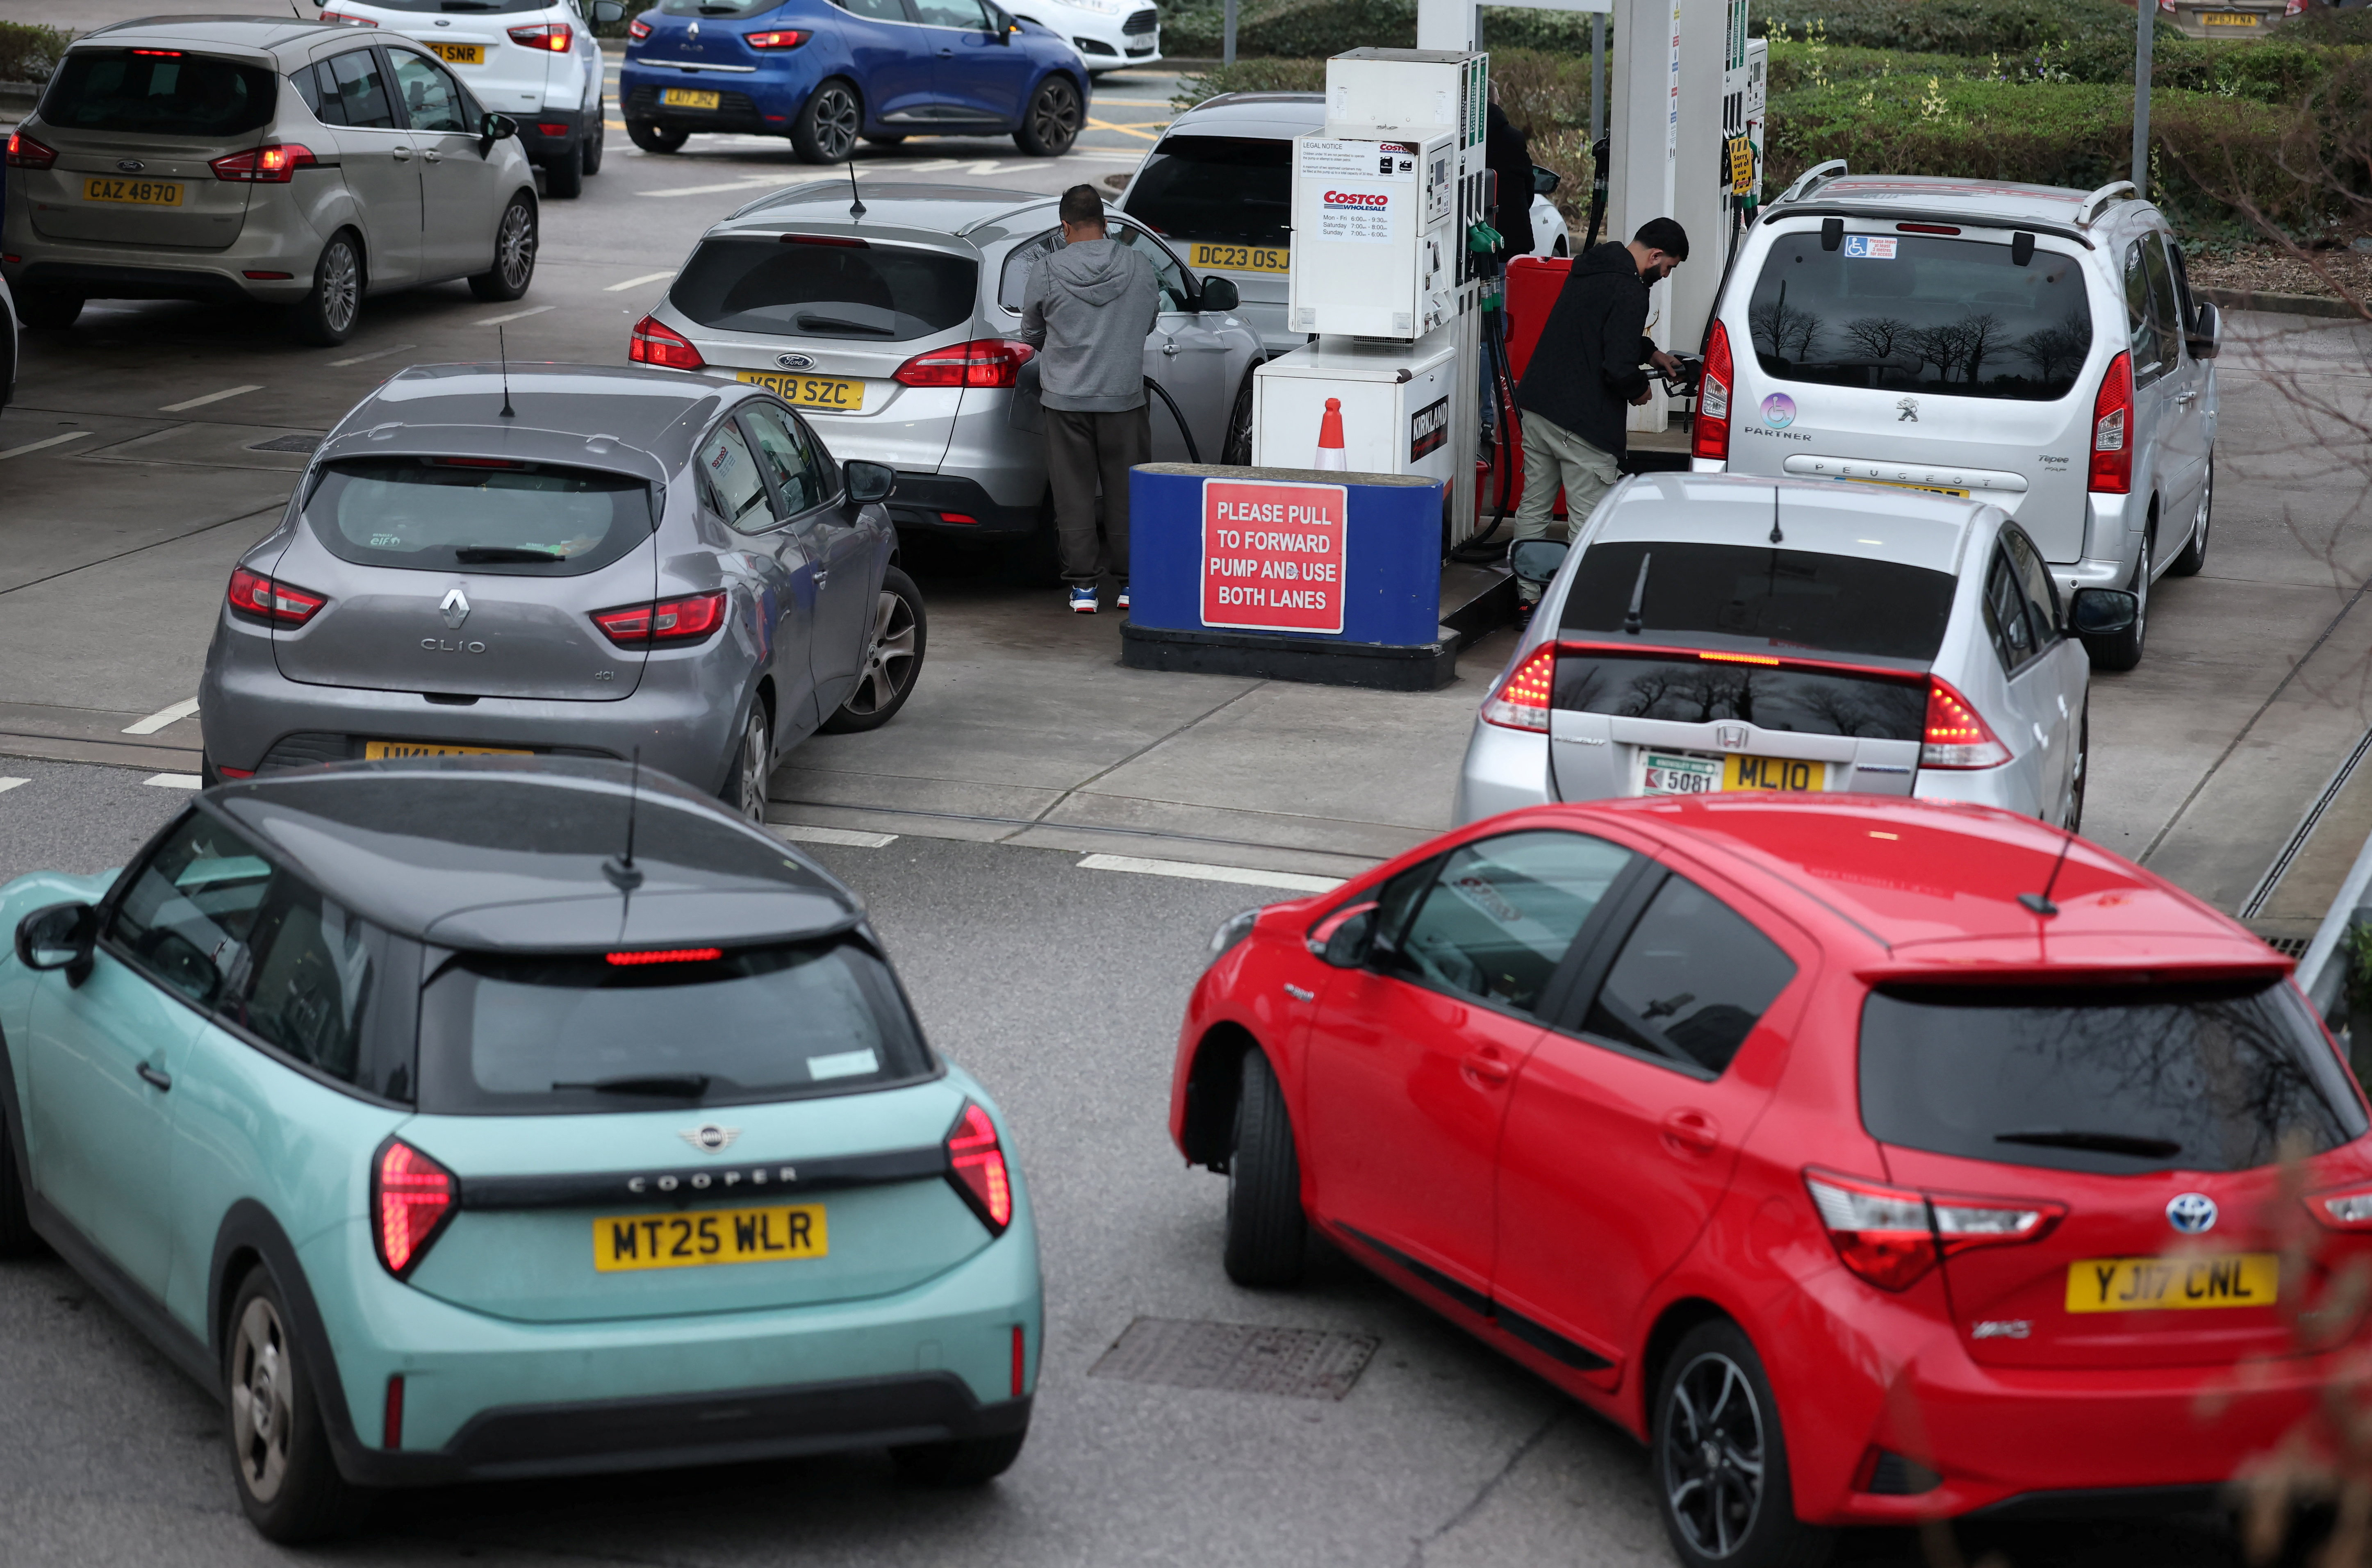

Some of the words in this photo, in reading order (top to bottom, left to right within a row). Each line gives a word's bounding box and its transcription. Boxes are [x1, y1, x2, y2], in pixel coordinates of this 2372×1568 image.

[447, 46, 476, 61] SNR
[90, 181, 125, 198] CAZ
[129, 183, 175, 202] 4870
[1324, 190, 1388, 206] COSTCO
[1199, 246, 1248, 266] DC23
[1254, 250, 1290, 269] OSJ
[784, 356, 804, 366] Ford
[804, 381, 849, 404] SZC
[1413, 402, 1447, 441] KIRKLAND
[1745, 426, 1812, 441] PARTNER
[2039, 454, 2069, 464] Tepee
[1815, 463, 1991, 487] PEUGEOT
[1218, 501, 1284, 523] PLEASE
[1288, 505, 1332, 525] PULL
[370, 537, 389, 545] elf
[1217, 530, 1240, 548] TO
[1245, 531, 1330, 553] FORWARD
[1210, 558, 1258, 577] PUMP
[1260, 560, 1298, 579] AND
[1302, 562, 1336, 582] USE
[1219, 586, 1265, 606] BOTH
[1270, 589, 1326, 610] LANES
[420, 638, 486, 653] CLIO
[1668, 771, 1711, 794] 5081
[1738, 758, 1810, 792] ML10
[628, 1166, 798, 1193] COOPER
[612, 1218, 722, 1261] MT25
[735, 1212, 811, 1253] WLR
[2096, 1265, 2171, 1304] YJ17
[2185, 1260, 2251, 1299] CNL
